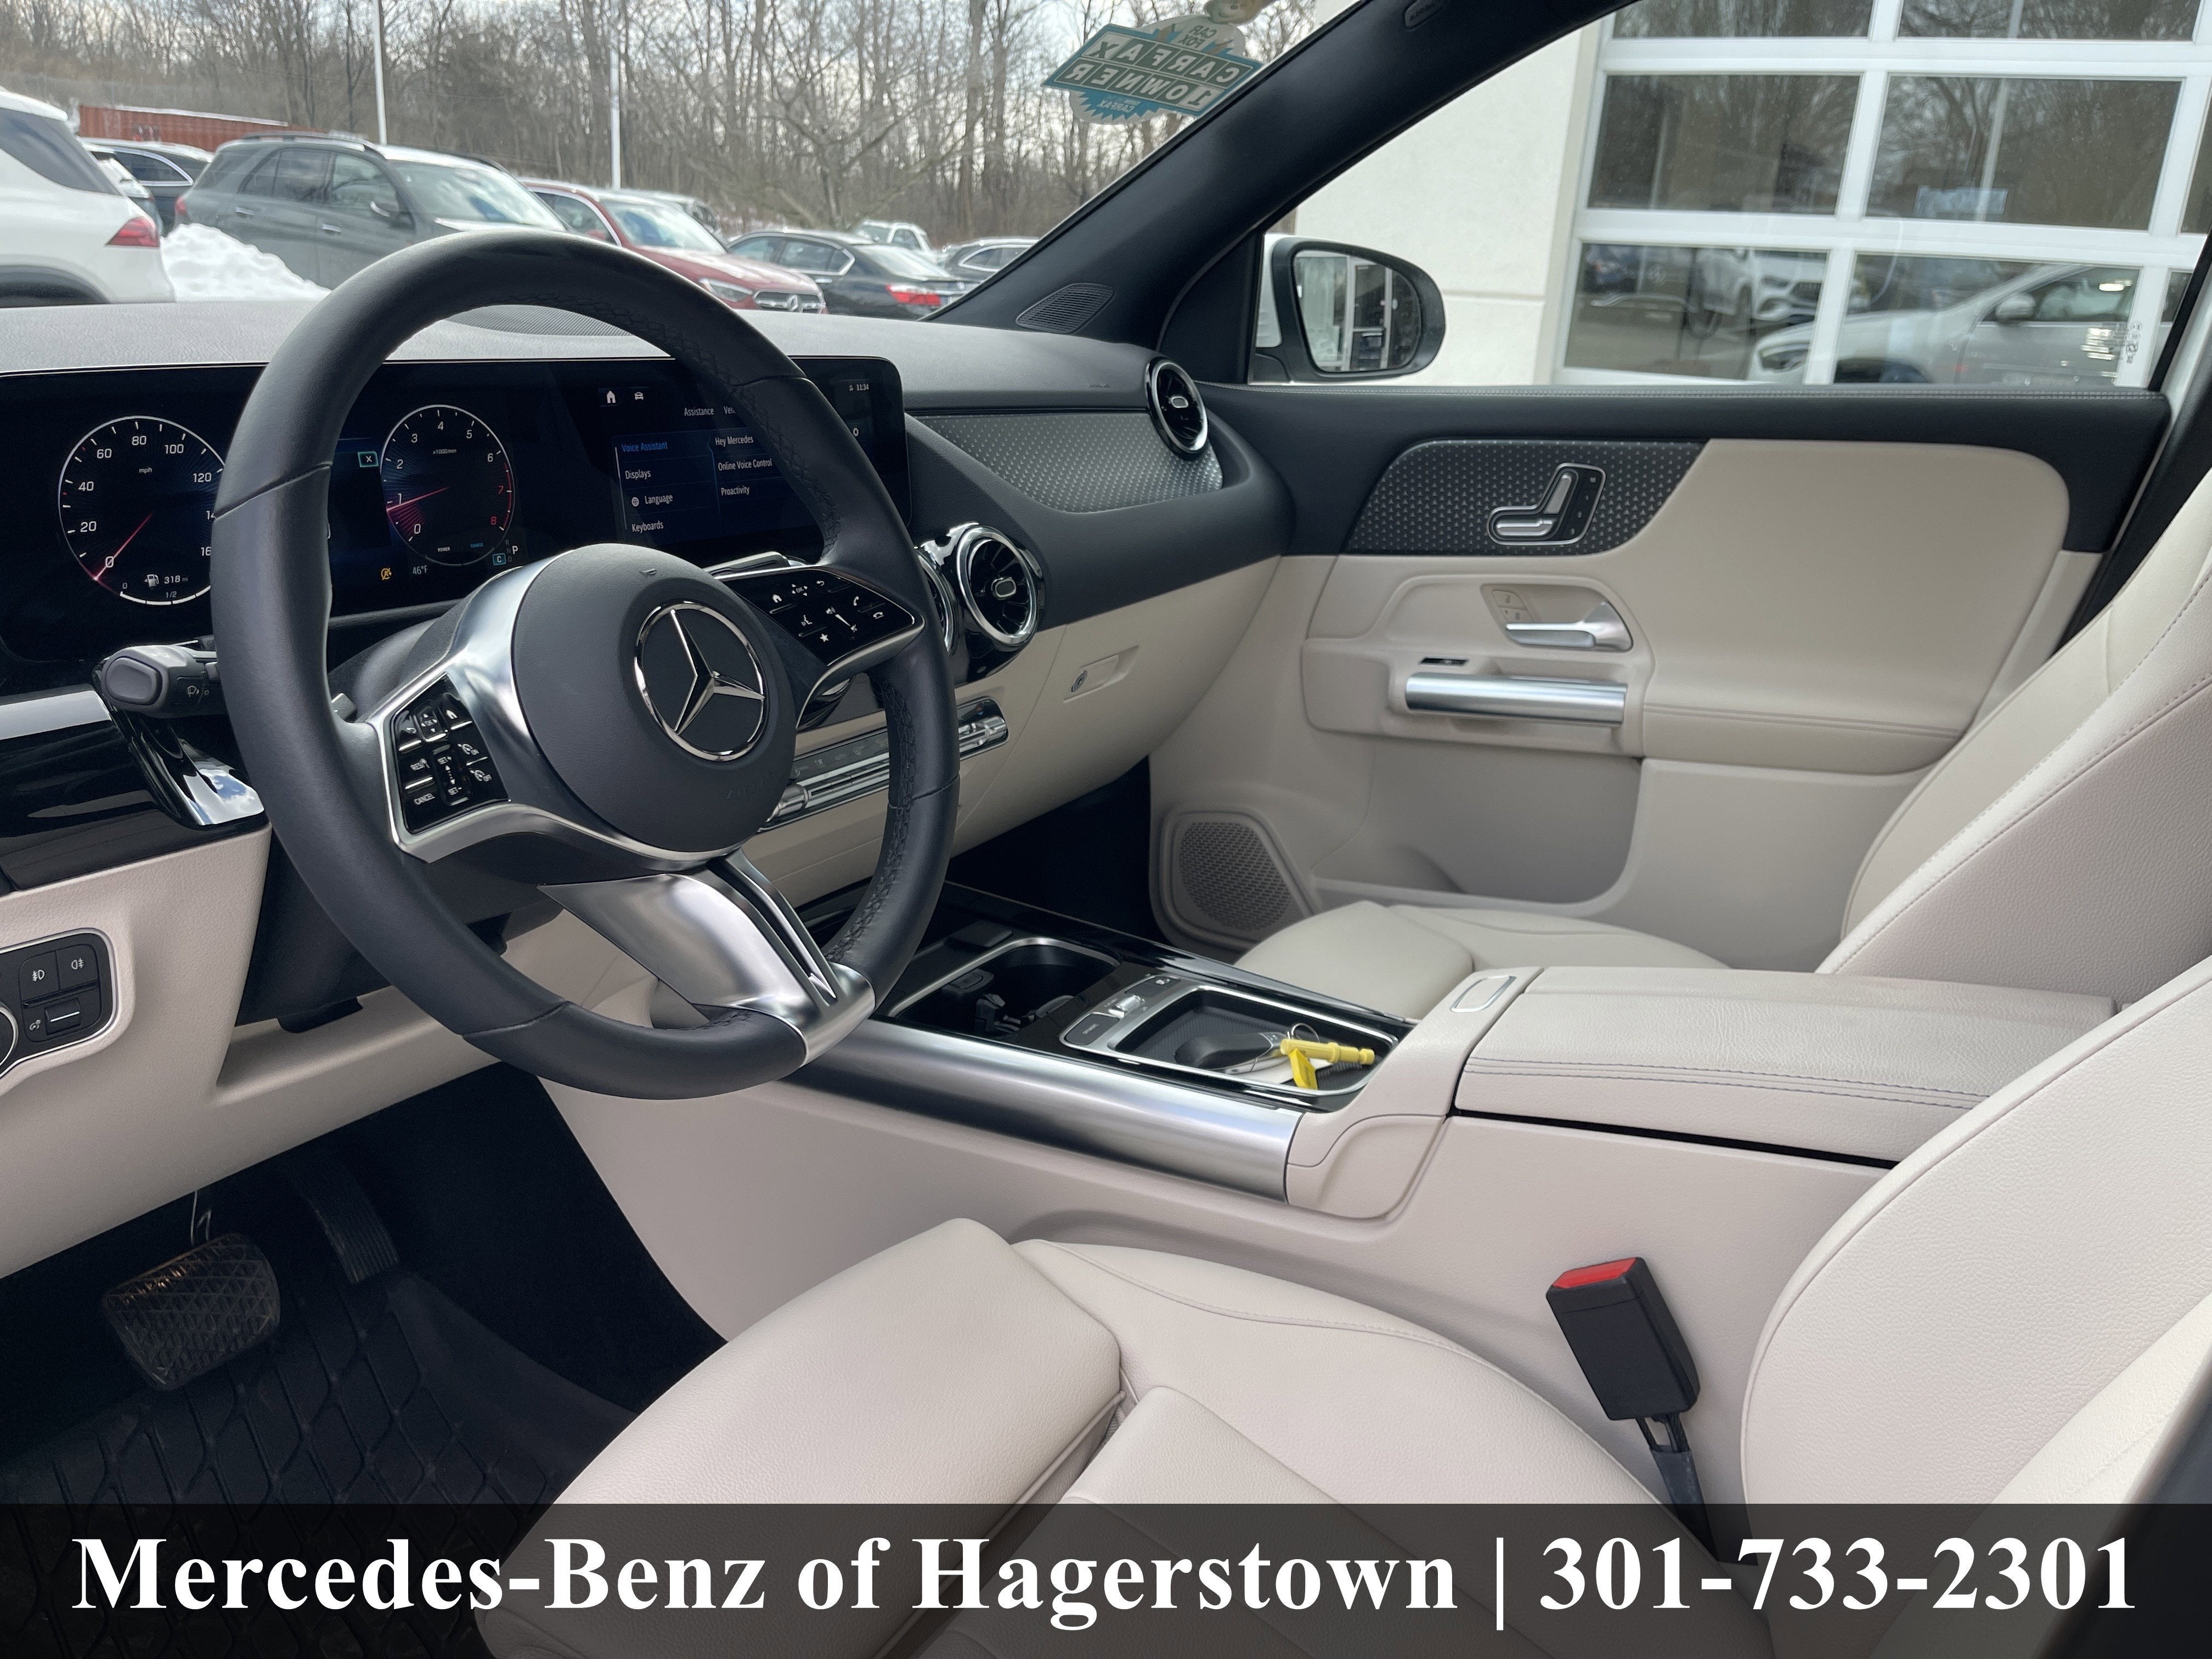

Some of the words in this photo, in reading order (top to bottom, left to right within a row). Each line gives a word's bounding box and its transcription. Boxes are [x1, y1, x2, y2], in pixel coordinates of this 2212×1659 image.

[684, 407, 714, 416] Assistance
[437, 421, 444, 431] 4
[411, 433, 418, 443] 3
[466, 429, 472, 439] 5
[132, 435, 147, 446] 80
[715, 437, 726, 447] Hey
[727, 435, 754, 445] Mercedes
[165, 444, 184, 454] 100
[621, 443, 639, 452] Voice
[640, 441, 668, 450] Assistant
[97, 448, 112, 459] 60
[487, 453, 493, 462] 6
[397, 459, 403, 469] 2
[718, 461, 736, 471] Online
[736, 460, 752, 469] Voice
[753, 458, 773, 468] Control
[193, 472, 212, 483] 120
[625, 469, 651, 480] Displays
[78, 481, 94, 492] 40
[498, 485, 504, 494] 7
[721, 485, 750, 495] Proactivity
[397, 493, 403, 504] 1
[644, 495, 673, 505] Language
[490, 516, 496, 525] 8
[80, 521, 97, 532] 20
[414, 523, 421, 534] 0
[631, 520, 664, 534] Keyboards
[512, 545, 518, 555] P
[105, 556, 115, 568] 0
[164, 575, 180, 584] 318
[166, 590, 177, 599] 1/2
